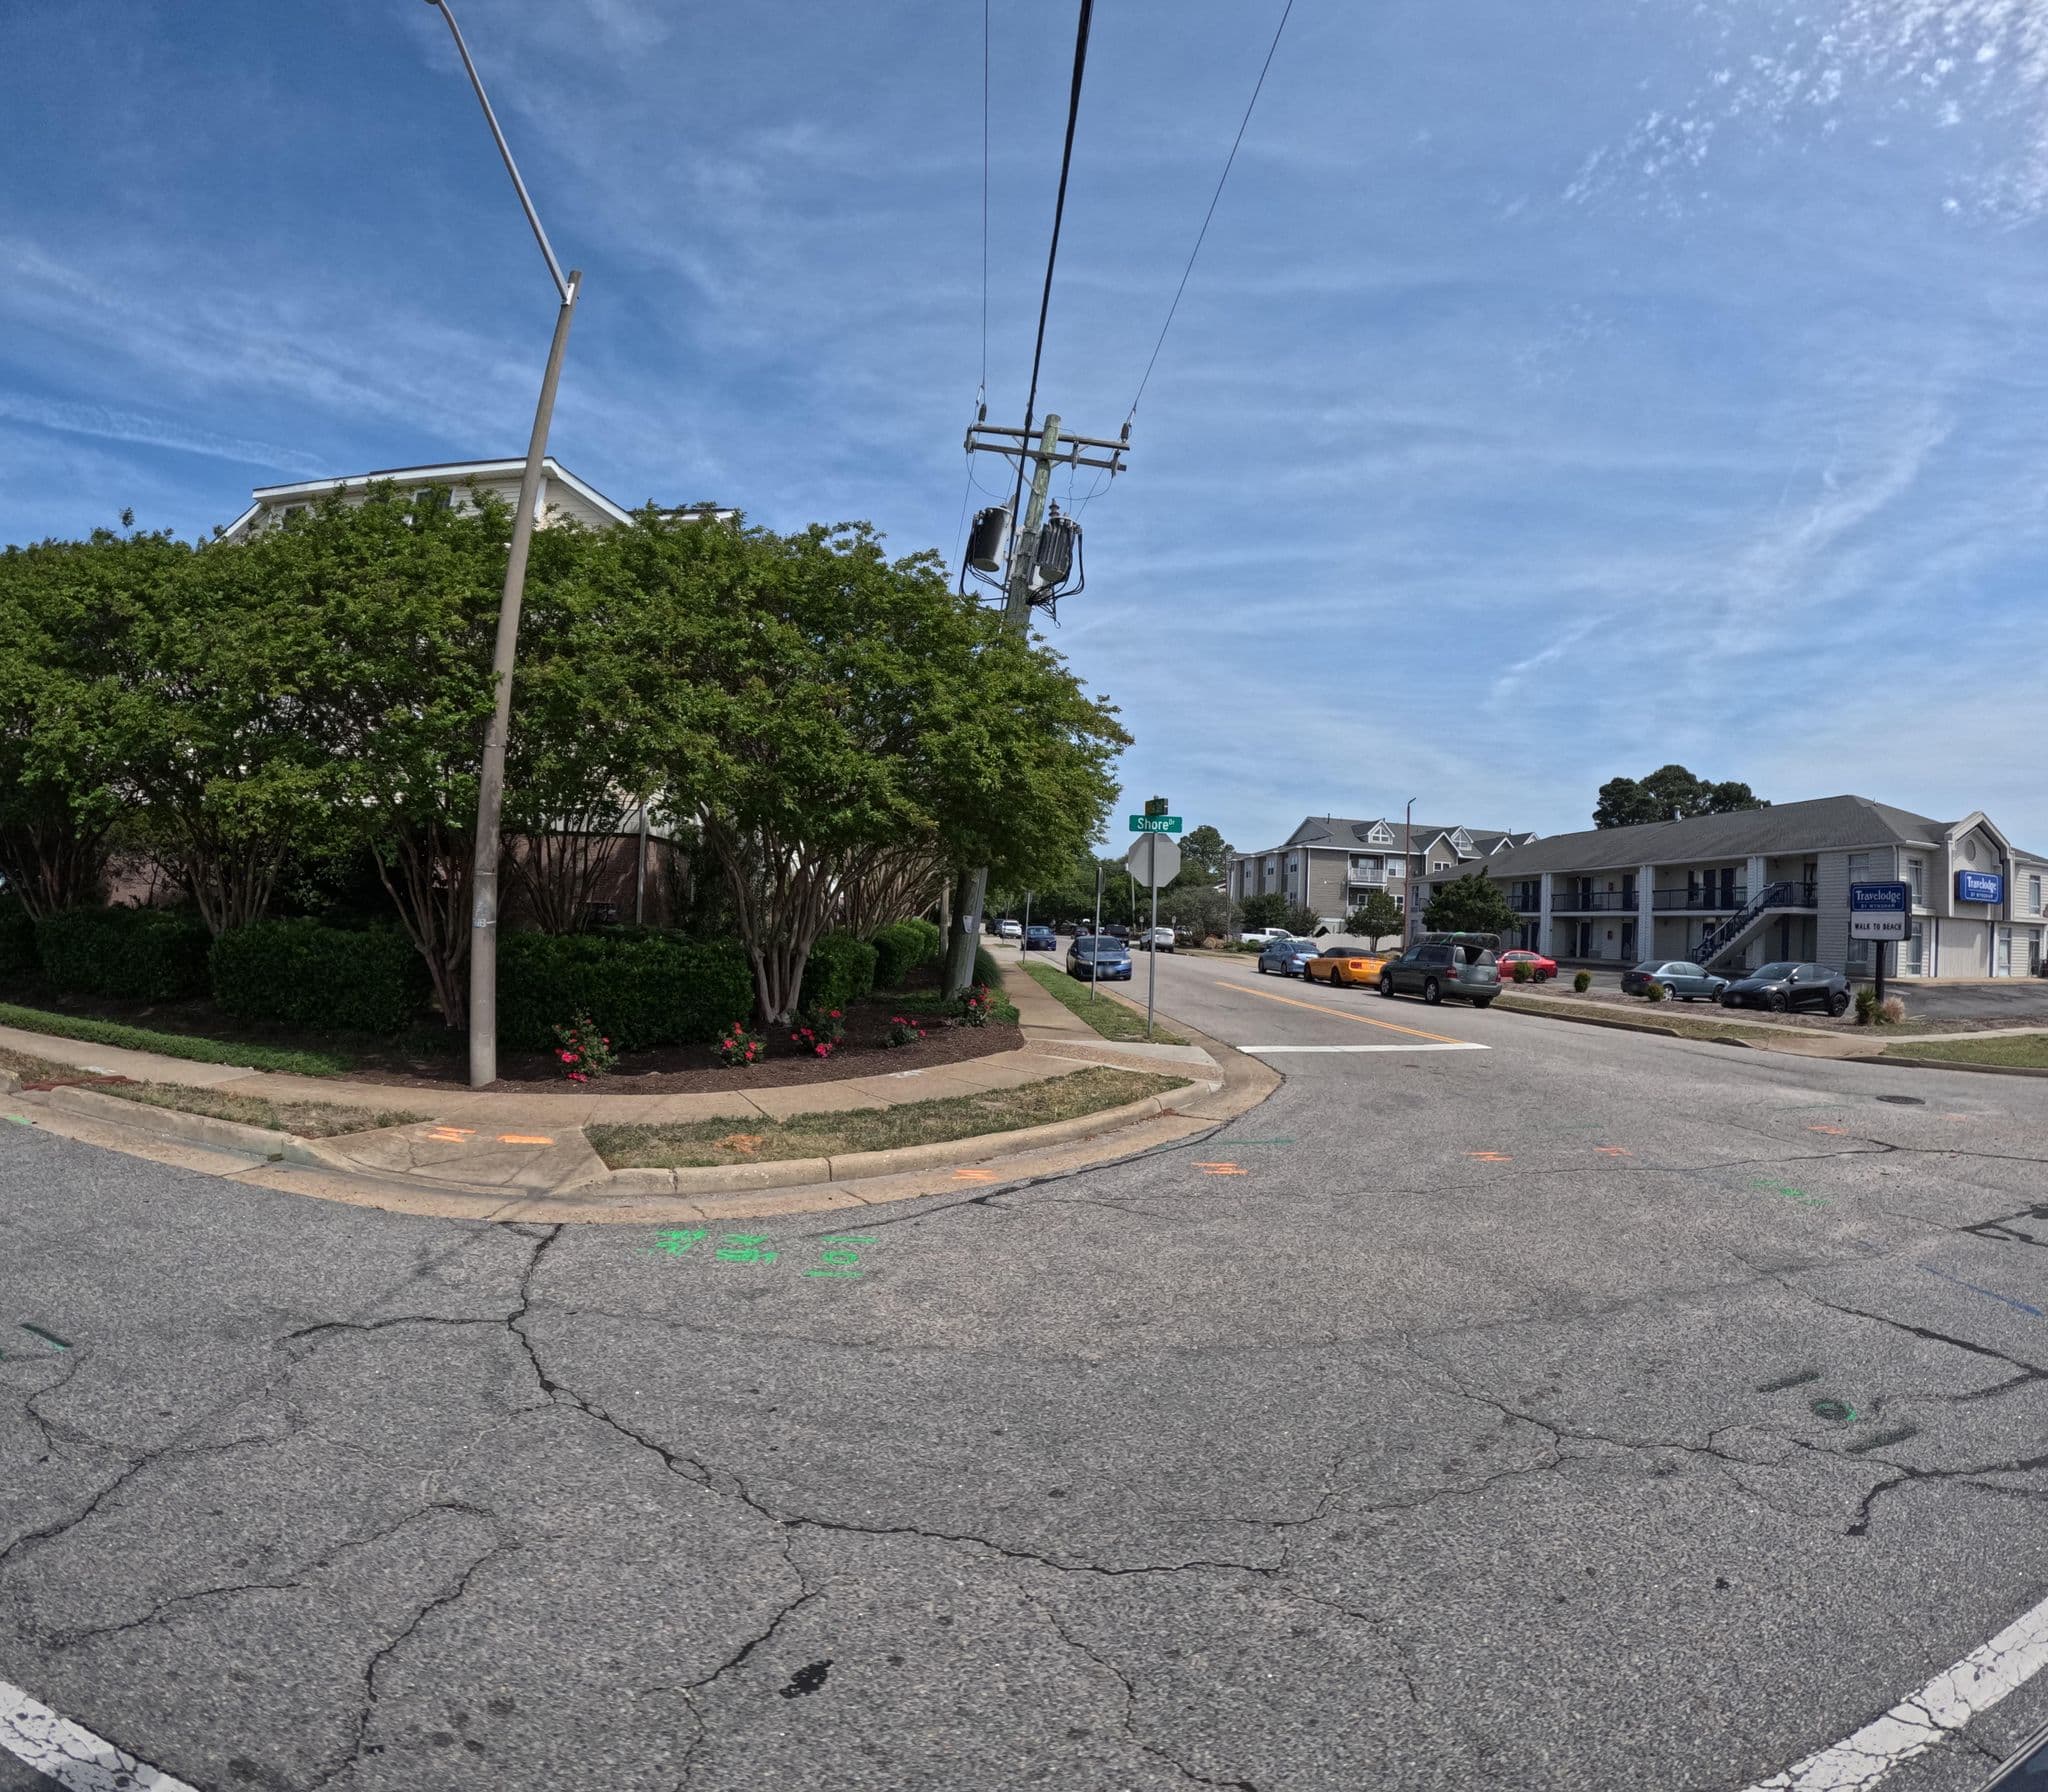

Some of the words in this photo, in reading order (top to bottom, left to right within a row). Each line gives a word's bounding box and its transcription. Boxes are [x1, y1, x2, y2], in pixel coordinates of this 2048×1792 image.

[1137, 817, 1169, 830] Shore
[1168, 818, 1176, 826] Dr
[1966, 876, 1997, 894] Travelodge
[1855, 889, 1902, 903] Travelodge
[1855, 922, 1870, 930] WALK
[1873, 922, 1881, 930] TO
[1883, 922, 1902, 931] BEACH
